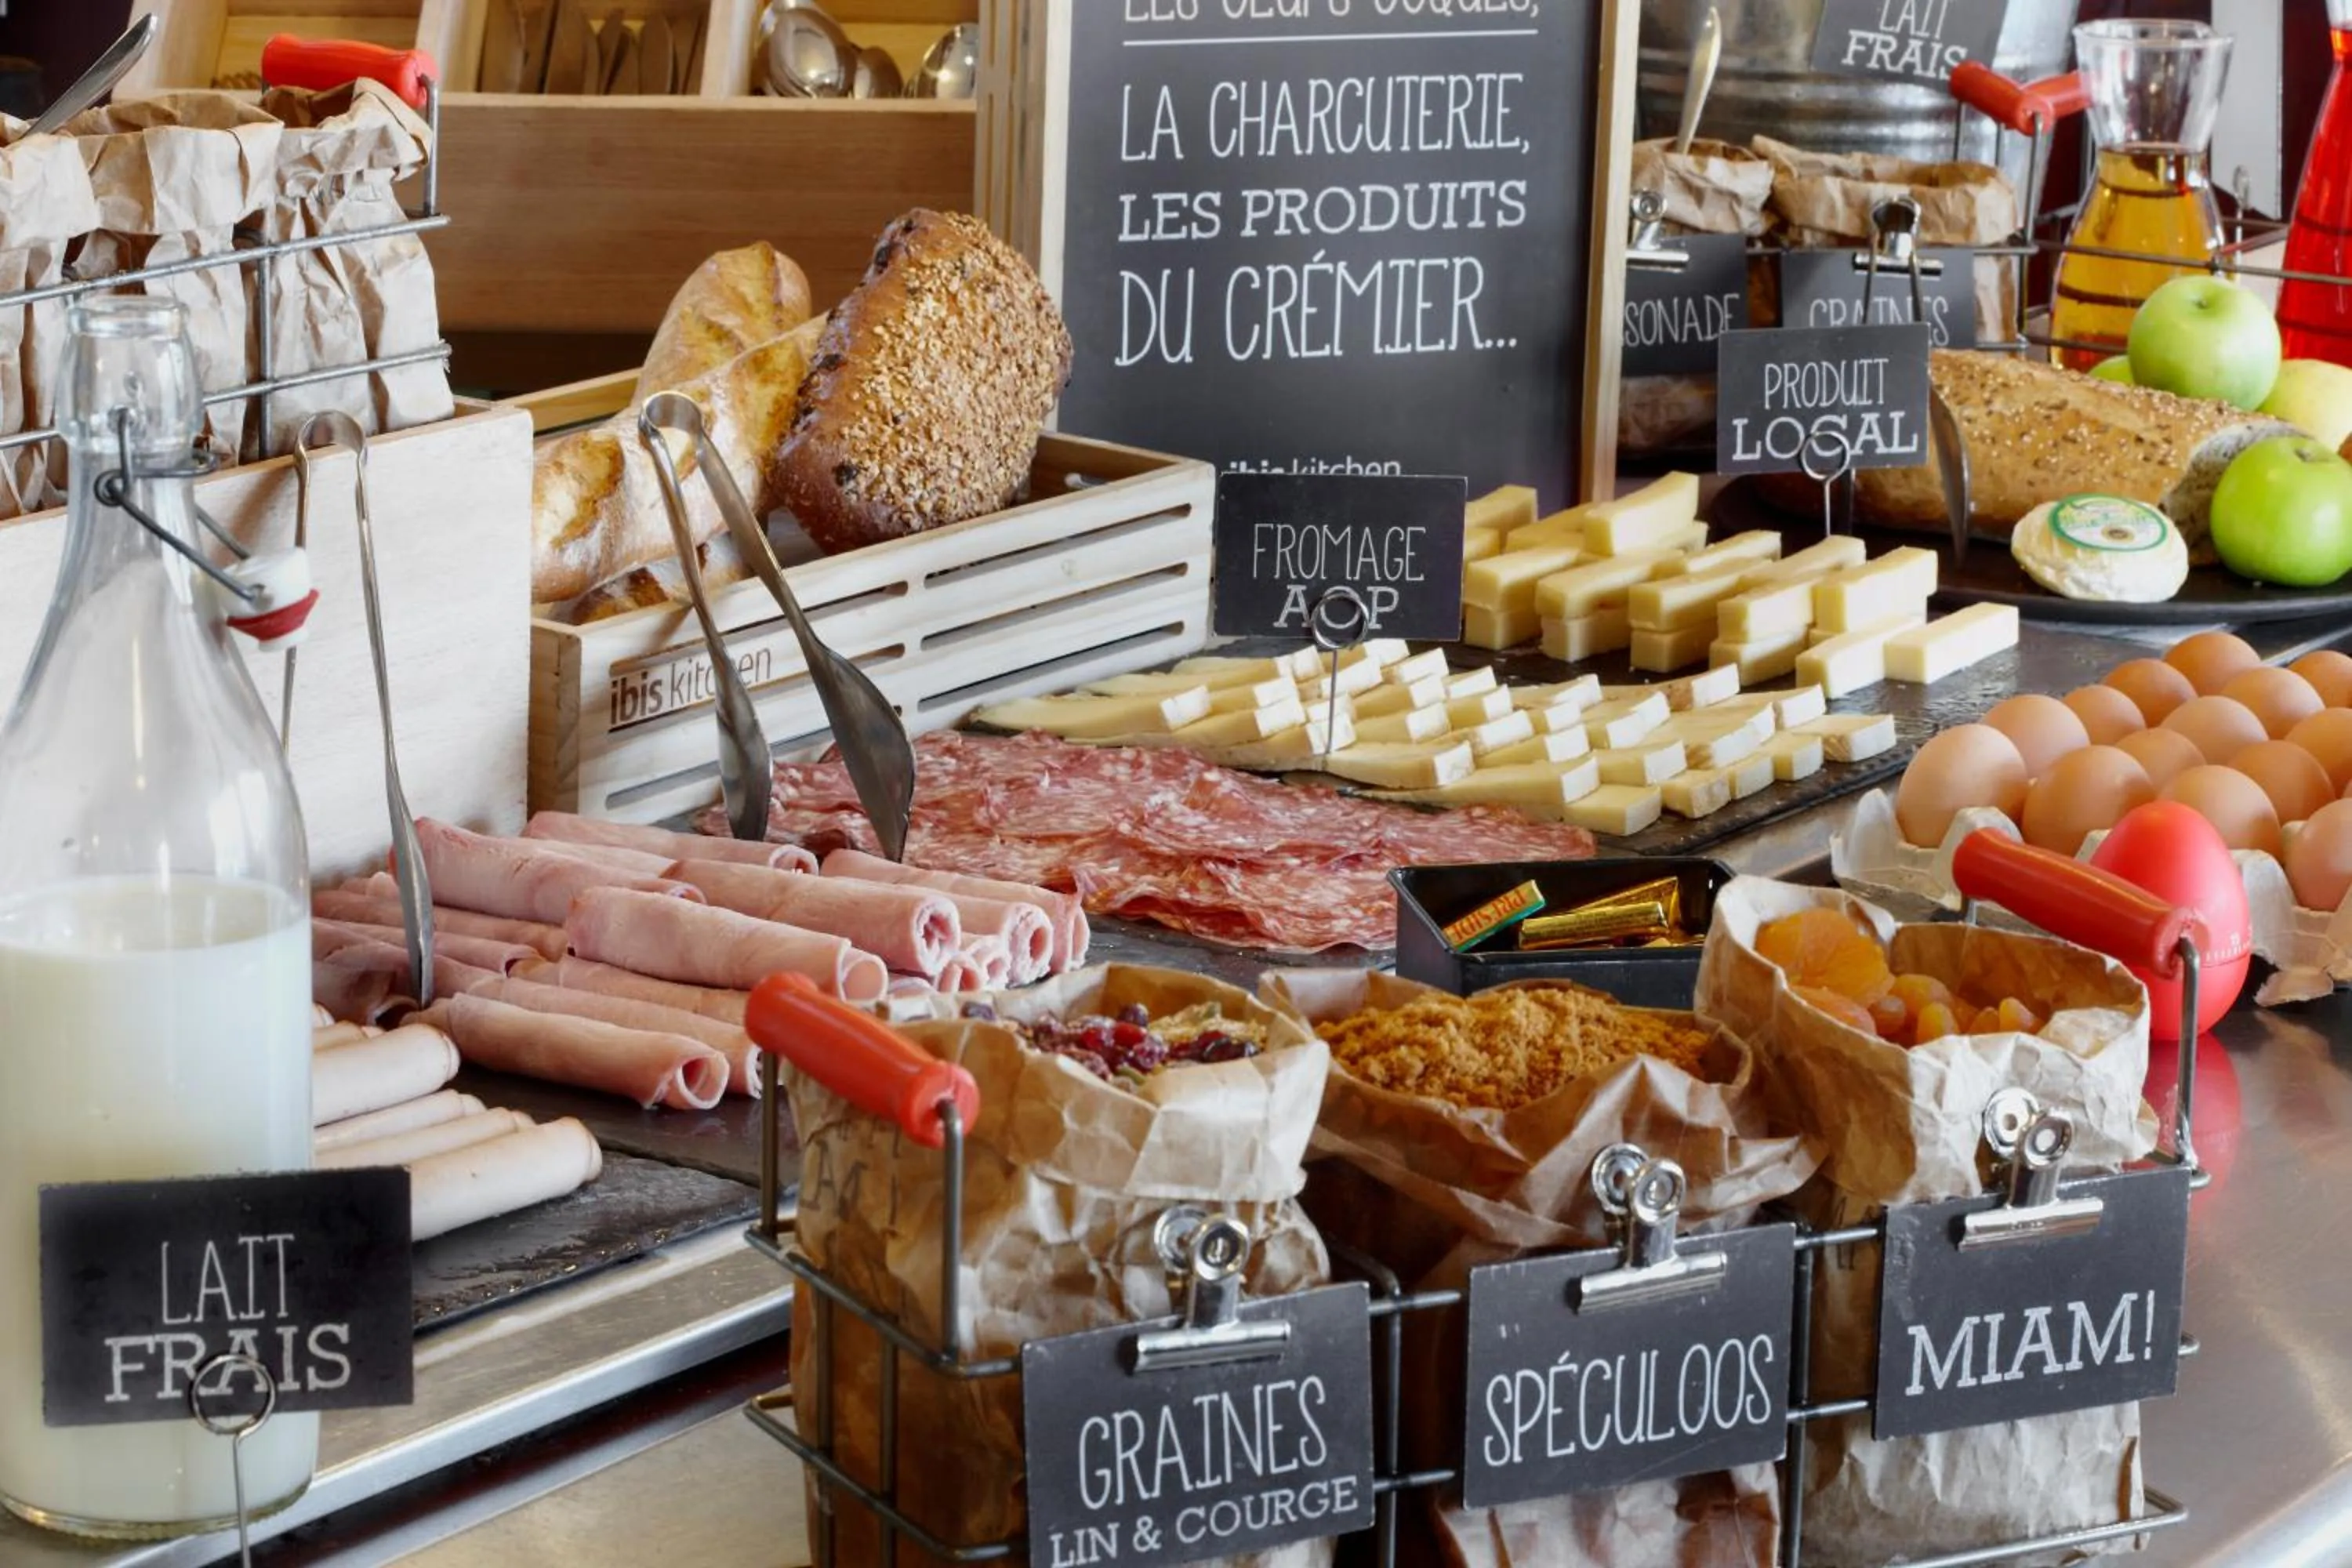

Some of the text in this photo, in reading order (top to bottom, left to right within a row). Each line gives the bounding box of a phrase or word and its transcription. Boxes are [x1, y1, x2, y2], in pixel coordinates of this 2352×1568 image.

[1841, 30, 1968, 80] FRAIS
[1879, 0, 1949, 39] LAIT
[1120, 73, 1530, 161] LA CHARCUTERIE,
[1118, 180, 1527, 241] LES PRODUITS
[1115, 267, 1194, 366] DU
[1764, 358, 1889, 409] PRODUIT
[1732, 411, 1918, 460] LOCAL
[1253, 524, 1426, 582] FROMAGE
[1273, 584, 1399, 630] AOP
[610, 648, 772, 724] ibis kitcen
[162, 1233, 295, 1324] LAIT
[104, 1323, 351, 1403] FRAIS
[1905, 1290, 2155, 1396] MIAM!
[1484, 1334, 1773, 1466] SPÉCULOOS
[1079, 1376, 1327, 1510] GRAINES
[1050, 1475, 1359, 1568] LIN & COURGE
